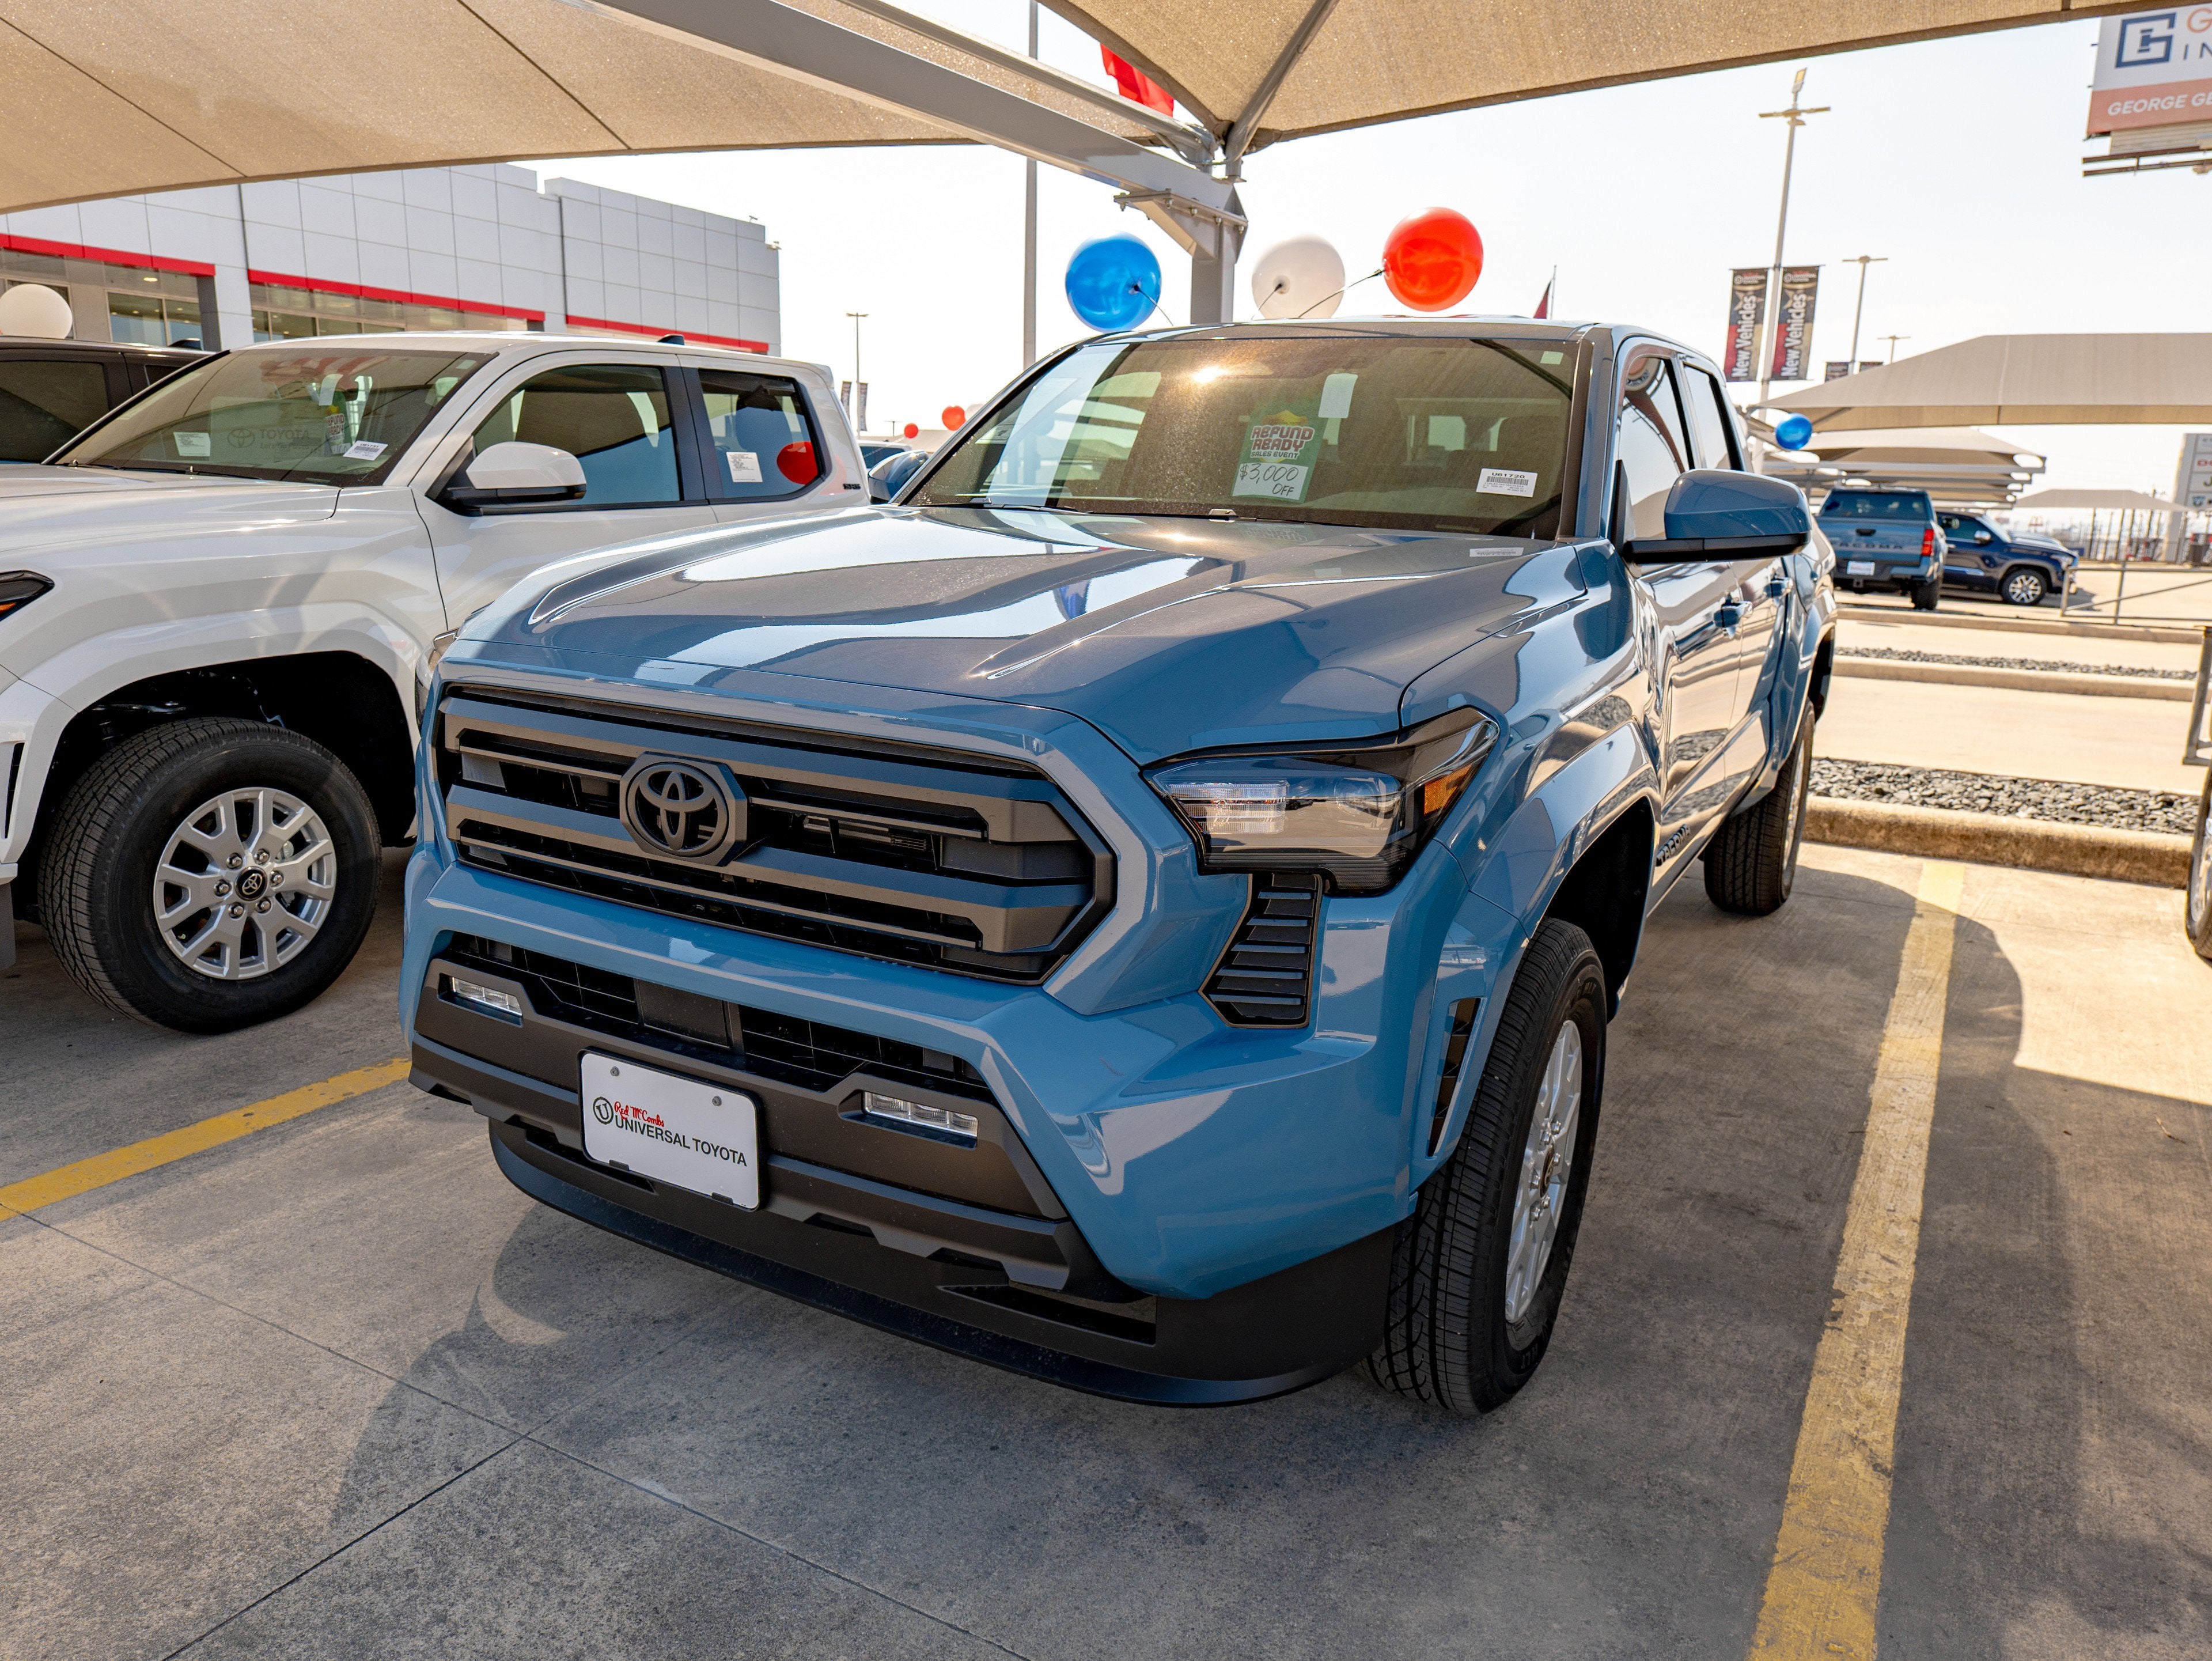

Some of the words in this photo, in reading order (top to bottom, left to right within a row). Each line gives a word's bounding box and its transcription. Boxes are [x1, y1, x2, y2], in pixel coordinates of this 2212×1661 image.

[2107, 94, 2188, 116] GEORGE
[1735, 294, 1756, 349] Vehicles
[1784, 293, 1807, 347] Vehicles
[1731, 349, 1751, 377] New
[1780, 348, 1801, 377] New
[1251, 426, 1314, 441] REFUND
[1252, 438, 1305, 452] READY
[1240, 463, 1299, 484] $3,000
[1272, 483, 1295, 496] OFF
[614, 1101, 629, 1119] Red
[630, 1105, 664, 1127] McCombs
[615, 1115, 691, 1149] UNIVERSAL
[692, 1137, 747, 1167] TOYOTA
